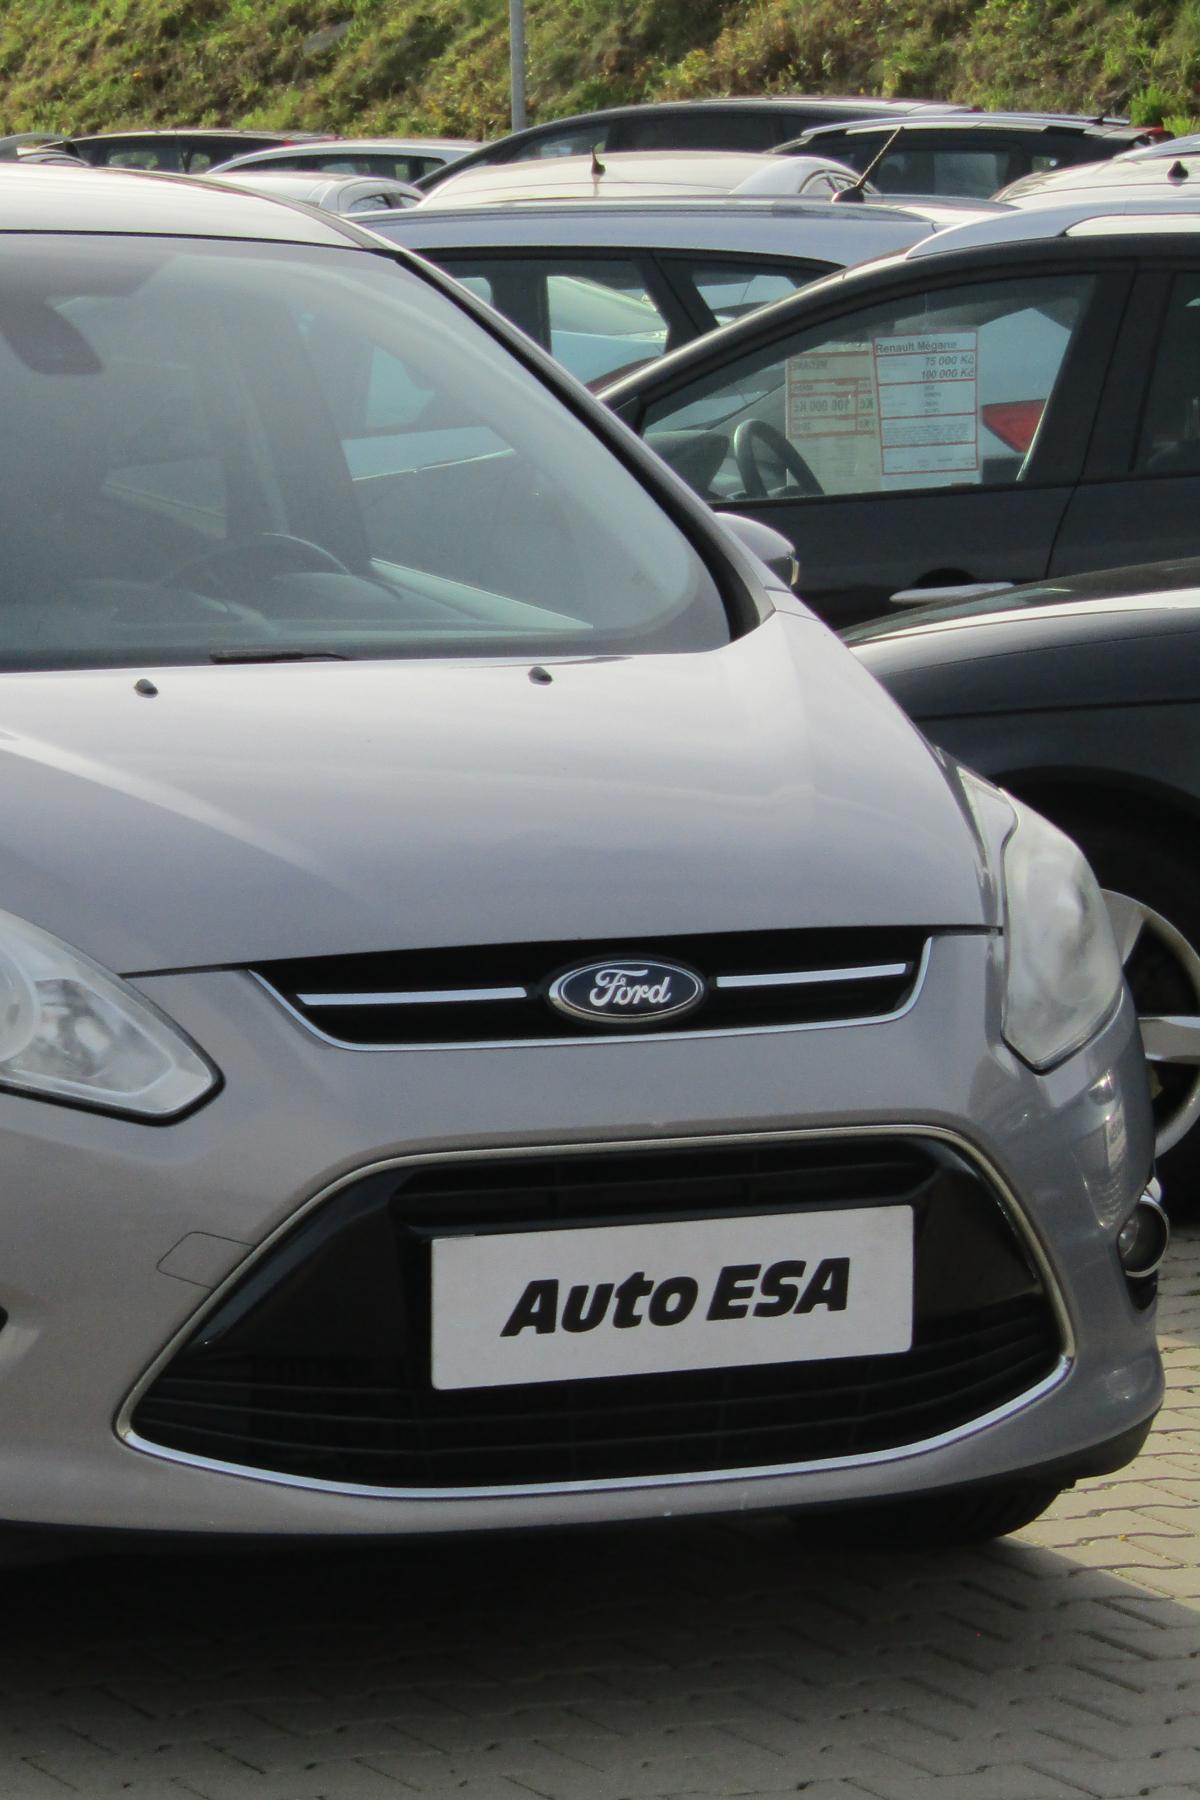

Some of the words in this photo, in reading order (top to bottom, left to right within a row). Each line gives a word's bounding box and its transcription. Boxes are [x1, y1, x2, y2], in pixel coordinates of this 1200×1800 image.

[876, 341, 915, 353] Renault
[924, 356, 937, 367] 75
[938, 356, 958, 366] 000
[938, 369, 958, 379] 000
[588, 967, 673, 1007] Ford
[499, 1271, 699, 1338] Auto
[706, 1257, 851, 1322] ESA
